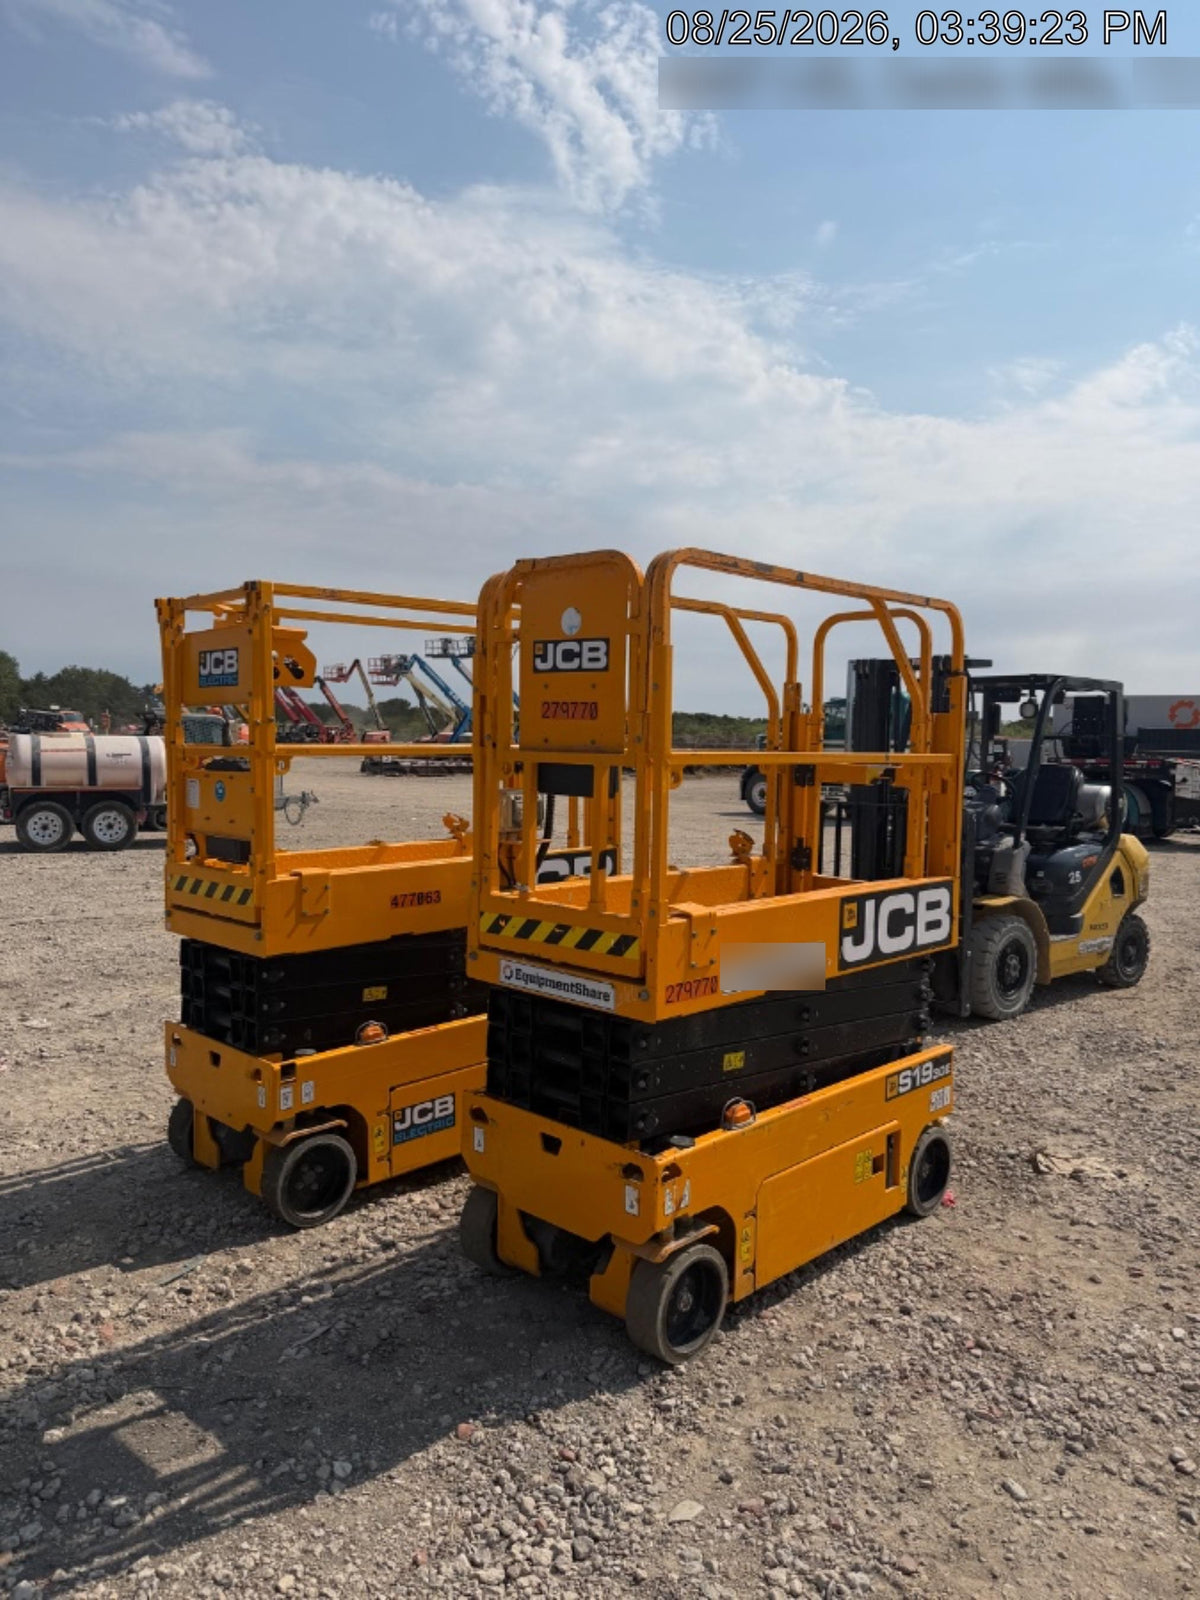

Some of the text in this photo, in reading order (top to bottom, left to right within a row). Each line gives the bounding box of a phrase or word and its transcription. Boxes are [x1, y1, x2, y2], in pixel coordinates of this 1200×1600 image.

[200, 650, 238, 676] JCB
[534, 641, 607, 670] JCB
[542, 701, 598, 720] 279770
[842, 887, 950, 962] JCB
[515, 968, 611, 1001] EquipmentShare
[665, 975, 719, 1004] 279770
[394, 1094, 455, 1131] JCB
[395, 1115, 454, 1145] ELECTRIC
